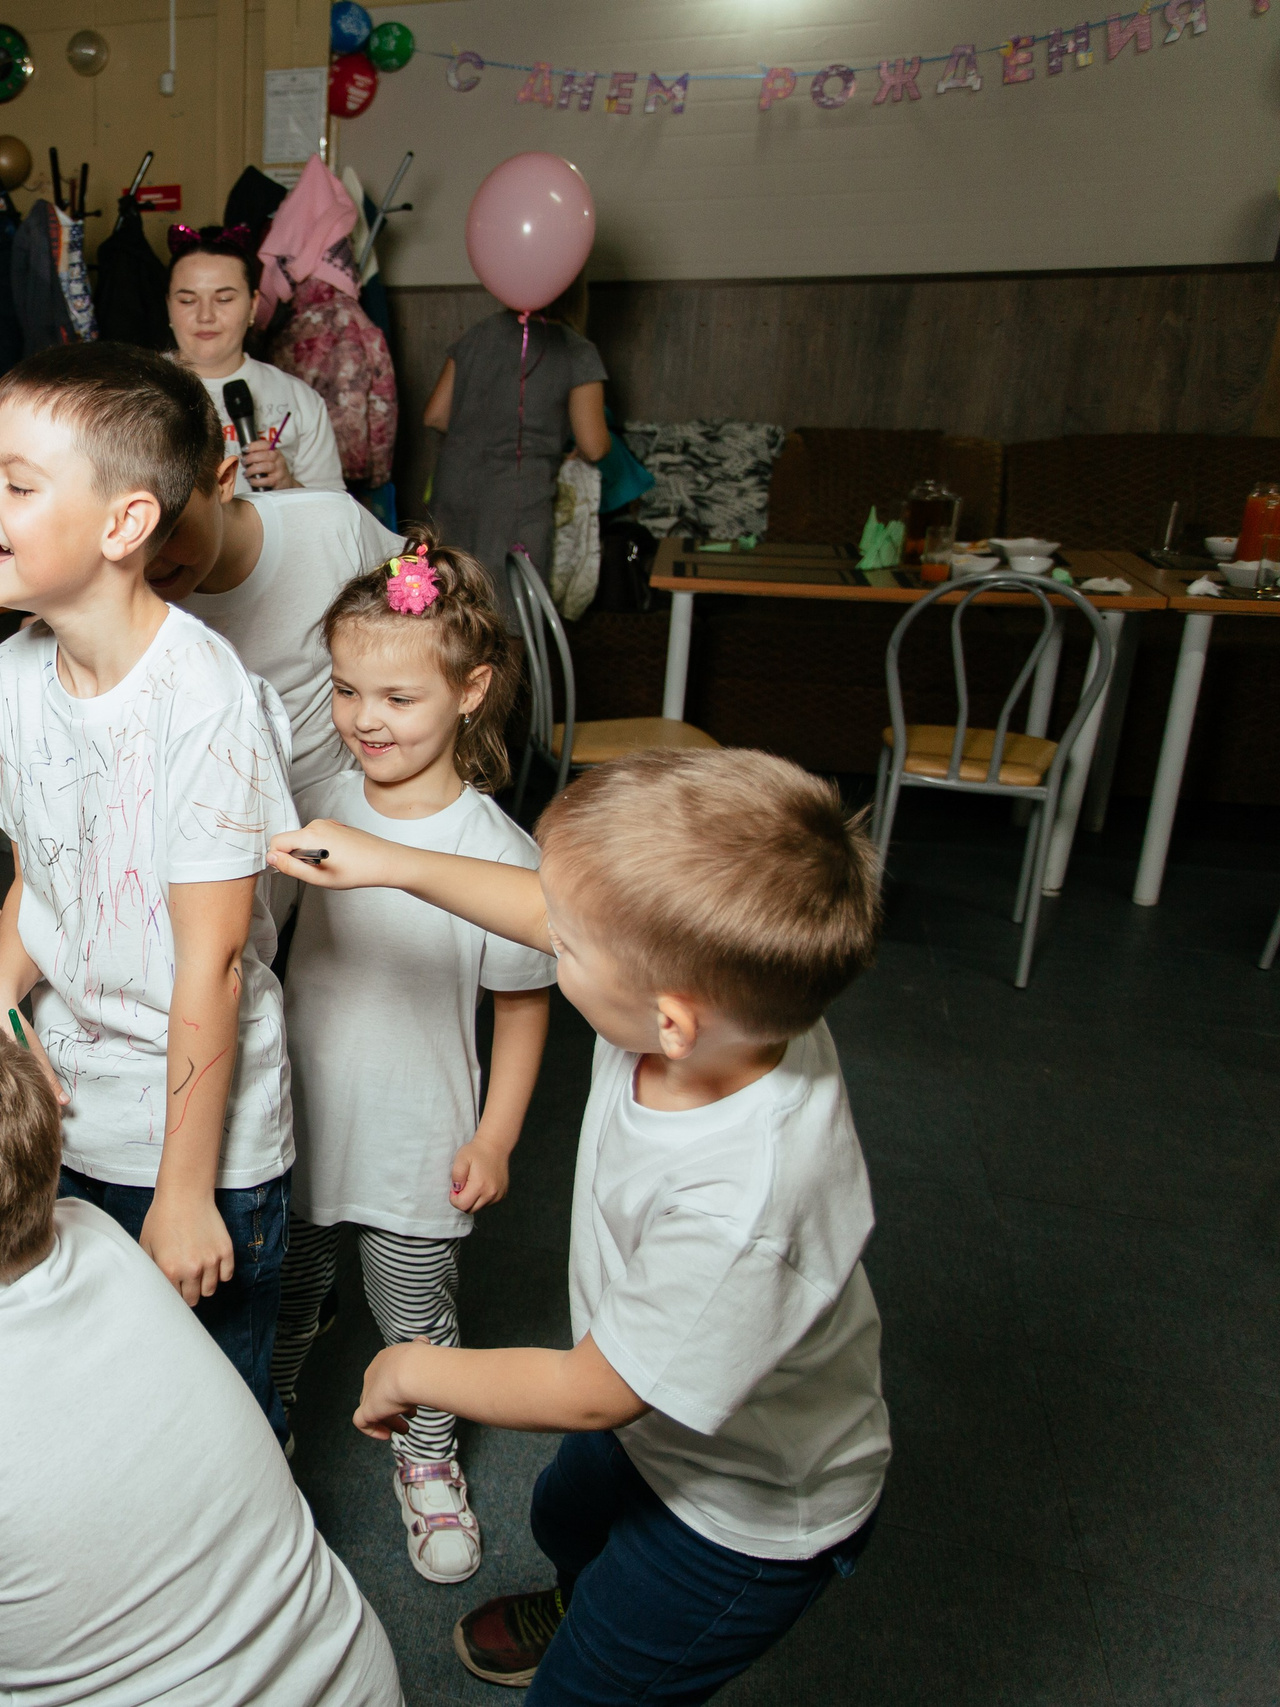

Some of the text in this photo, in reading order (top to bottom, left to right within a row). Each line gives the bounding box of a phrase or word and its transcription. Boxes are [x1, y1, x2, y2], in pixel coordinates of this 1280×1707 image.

[446, 0, 1208, 115] С ДНЕМ РОЖДЕНИЯ
